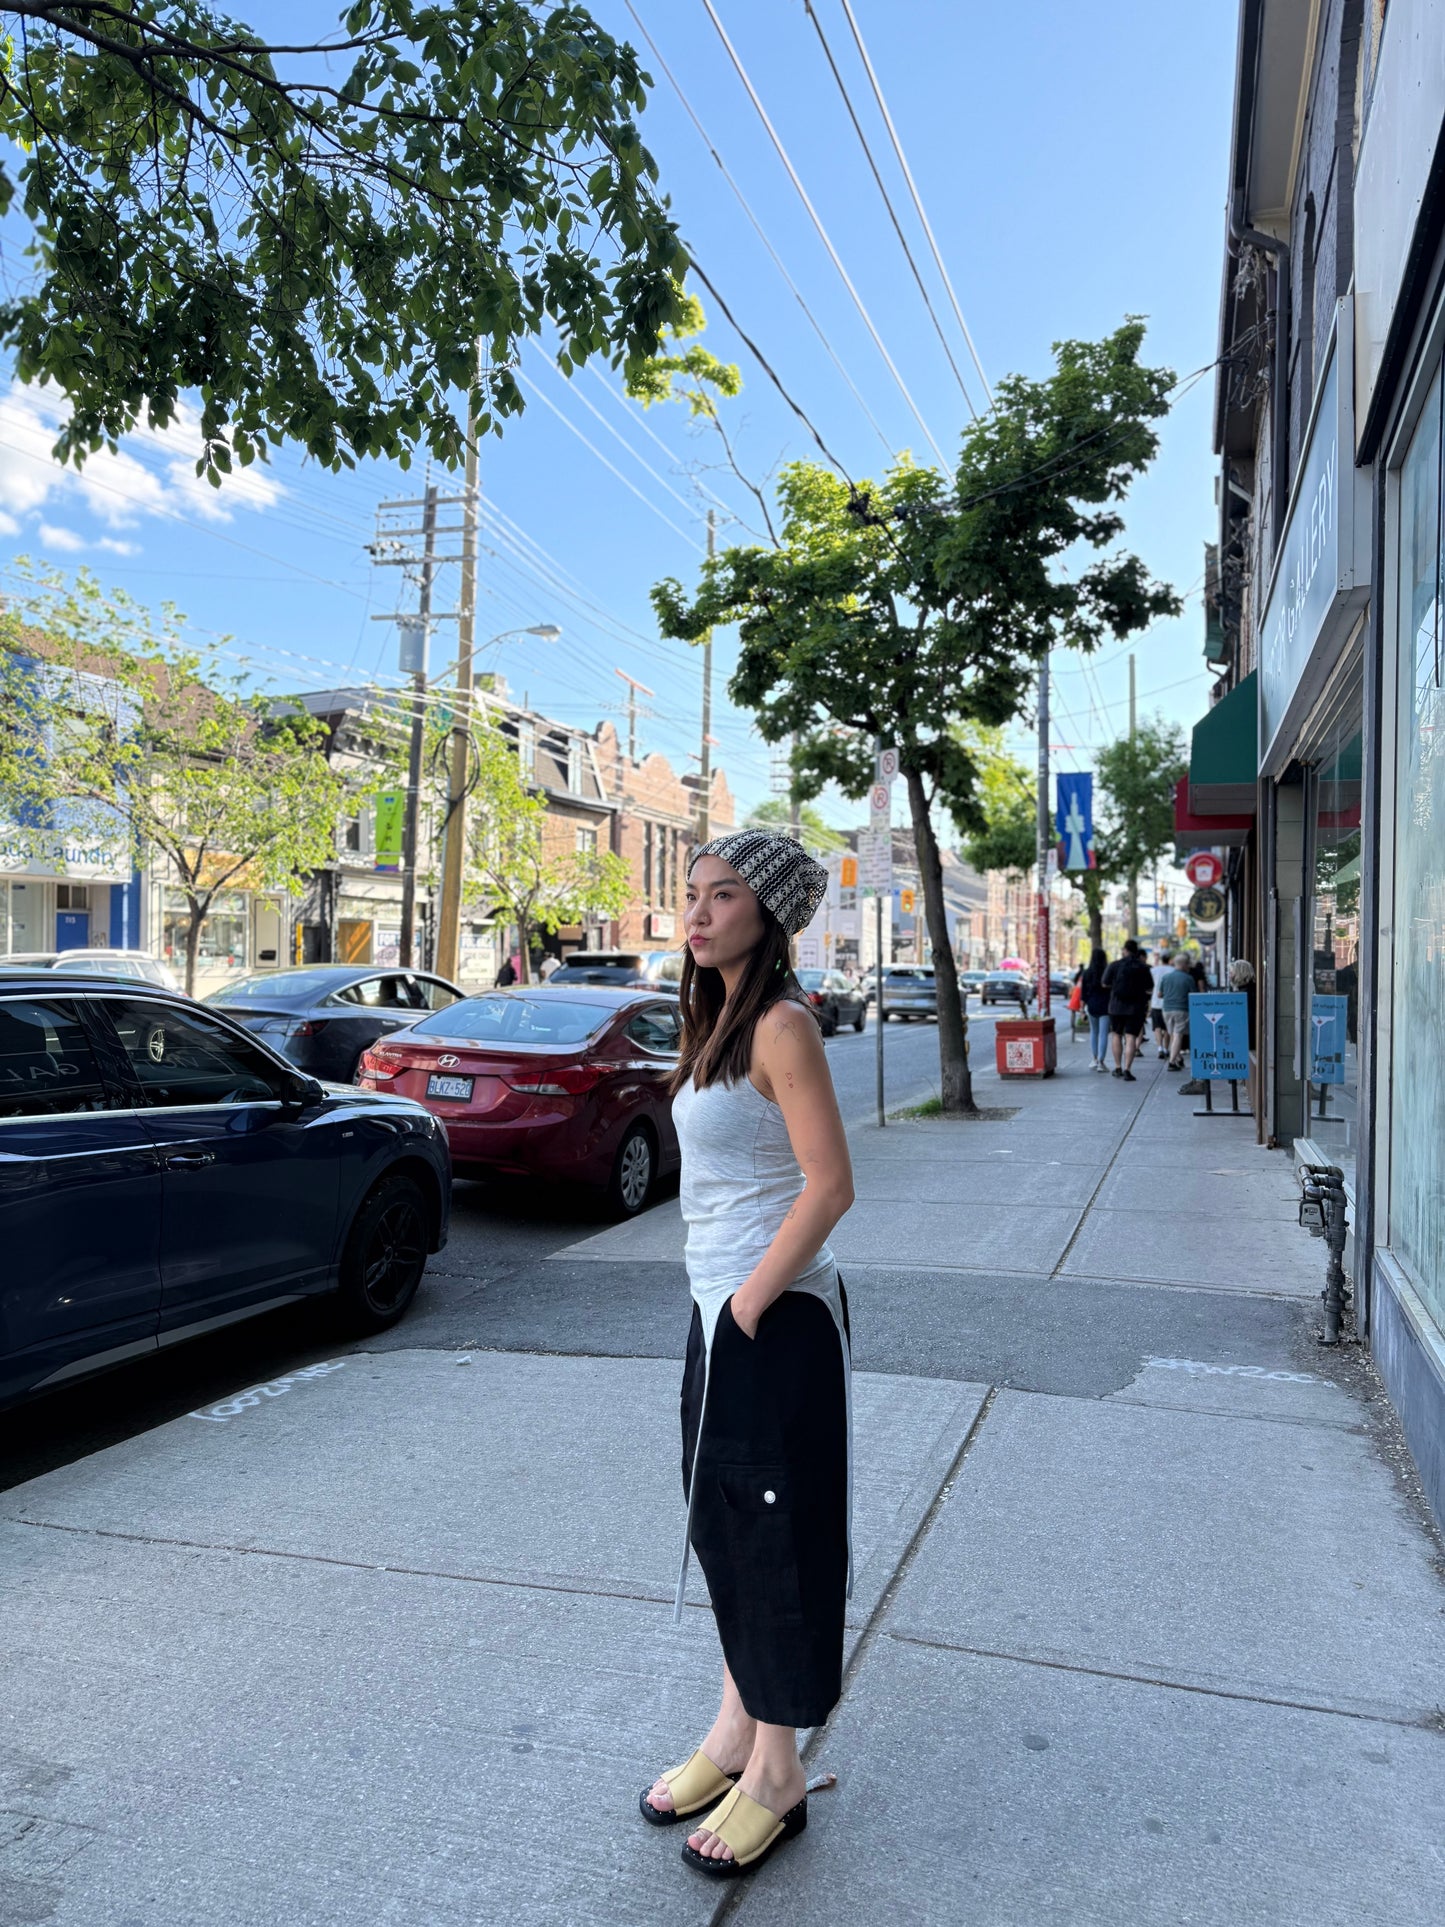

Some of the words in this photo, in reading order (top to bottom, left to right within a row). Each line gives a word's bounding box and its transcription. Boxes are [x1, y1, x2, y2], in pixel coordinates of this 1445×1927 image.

[1287, 440, 1335, 643] GALLERY
[42, 841, 117, 869] Laundry
[1194, 1048, 1219, 1059] Lost
[1222, 1048, 1234, 1059] in
[1201, 1060, 1246, 1070] Toronto
